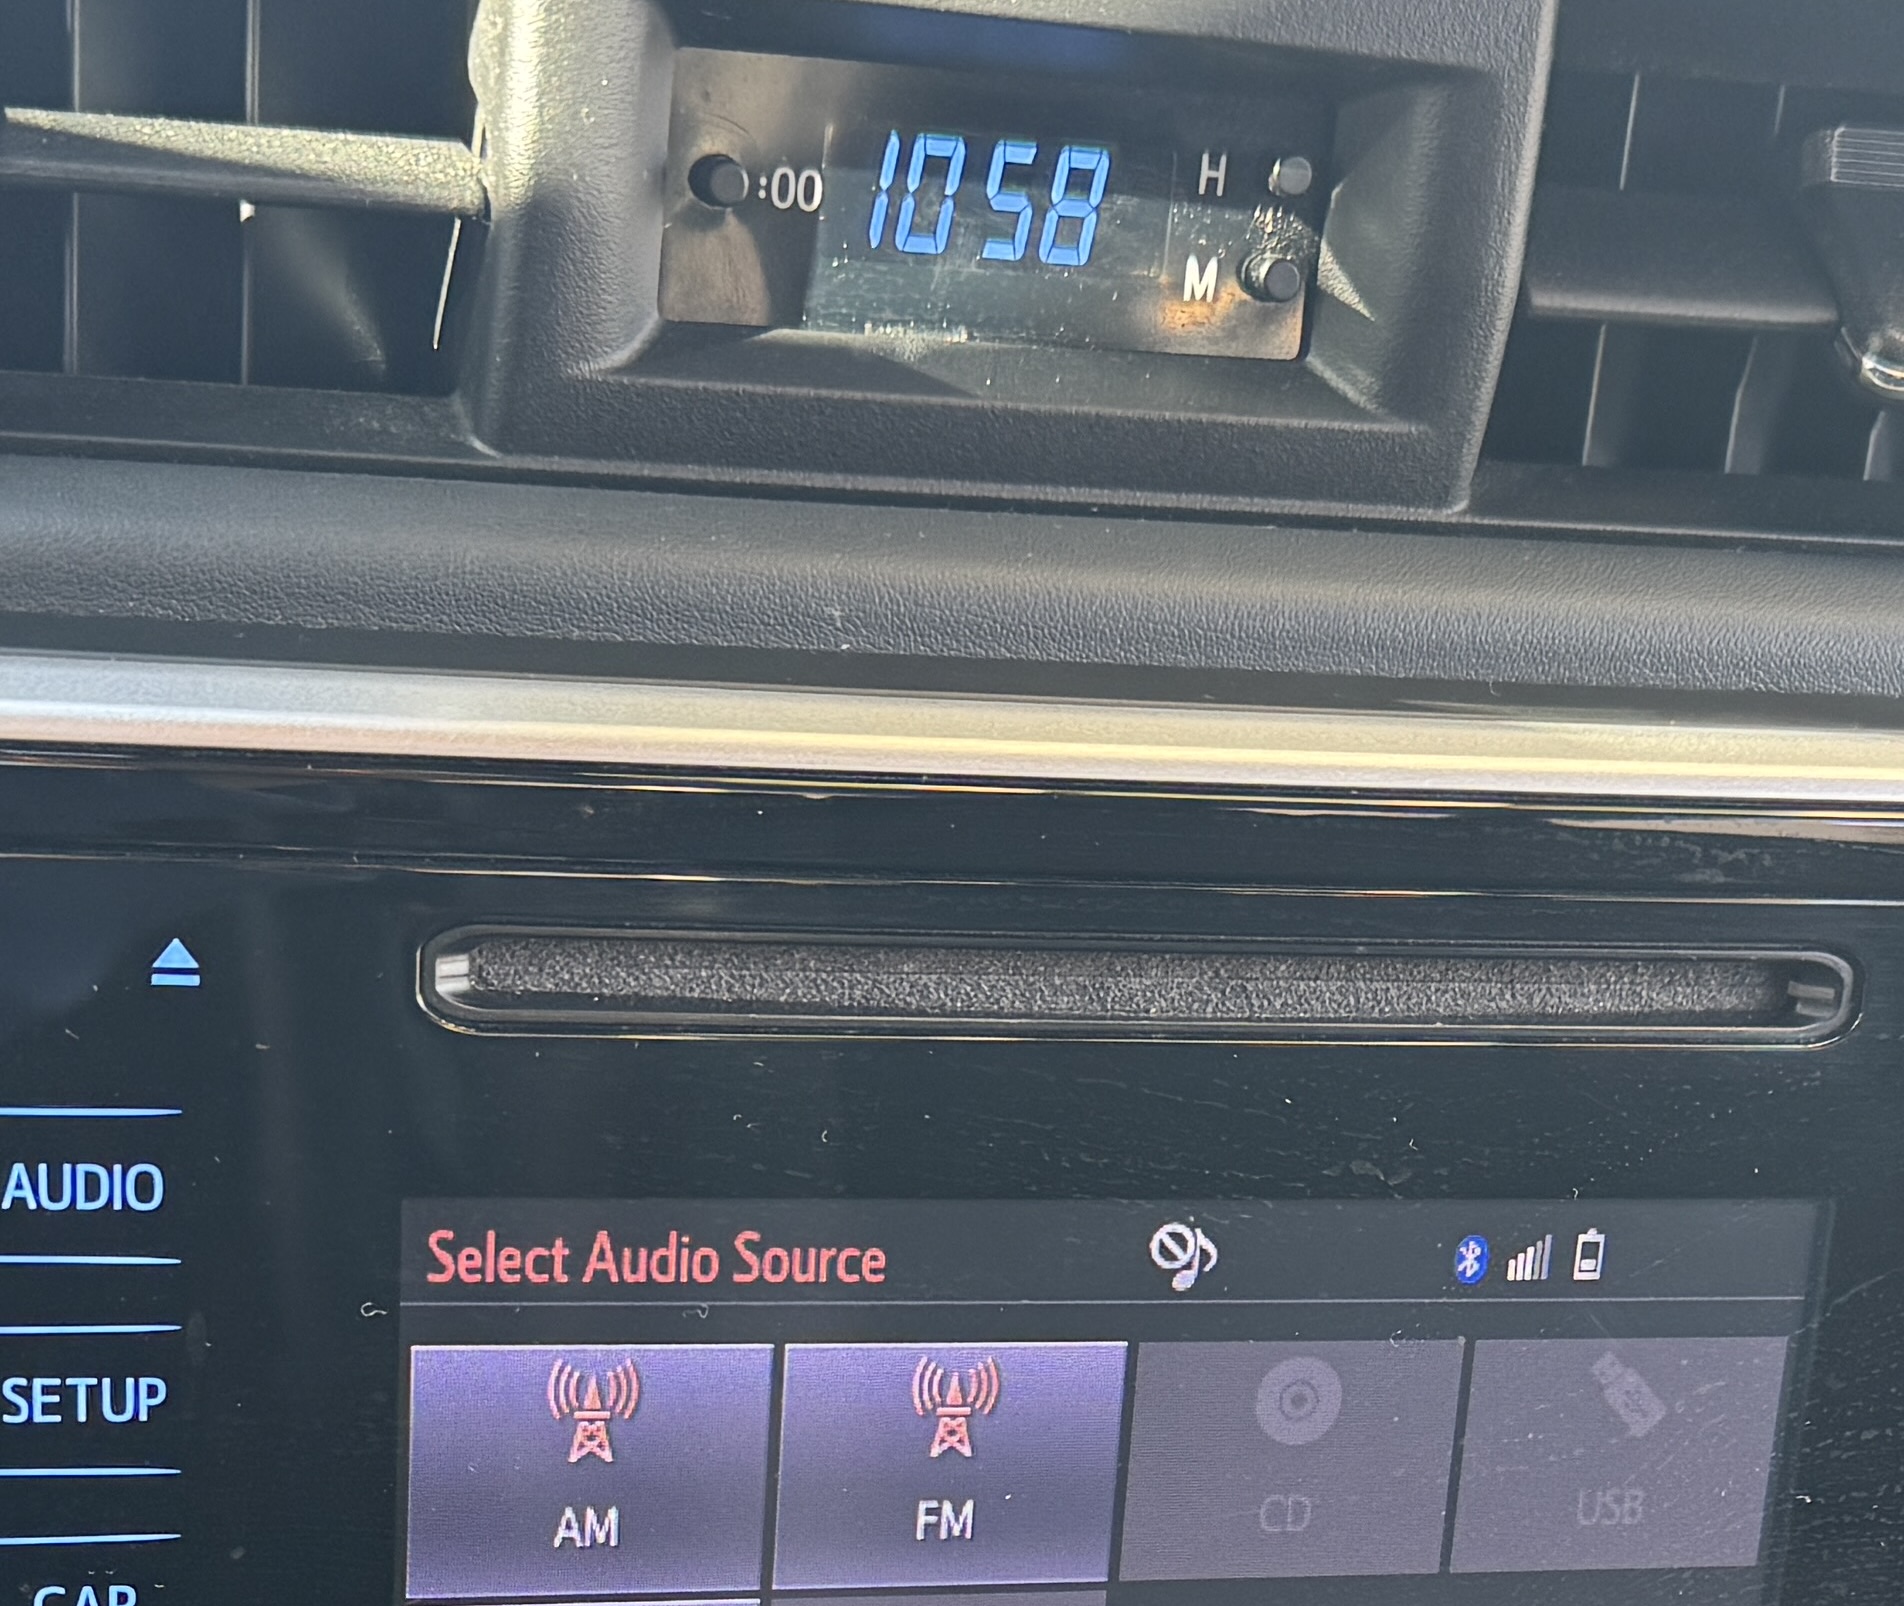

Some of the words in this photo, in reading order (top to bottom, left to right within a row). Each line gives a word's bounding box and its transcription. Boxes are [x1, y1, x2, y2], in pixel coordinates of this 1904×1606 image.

[757, 166, 823, 213] :00
[1198, 152, 1228, 197] H
[1182, 256, 1218, 304] M
[0, 1162, 165, 1212] AUDIO
[426, 1229, 569, 1284] Select
[582, 1230, 721, 1284] Audio
[732, 1230, 887, 1284] Source
[0, 1376, 169, 1424] SETUP
[552, 1506, 621, 1549] AM
[914, 1499, 975, 1541] FM
[1258, 1493, 1312, 1533] CD
[1576, 1488, 1645, 1528] USB
